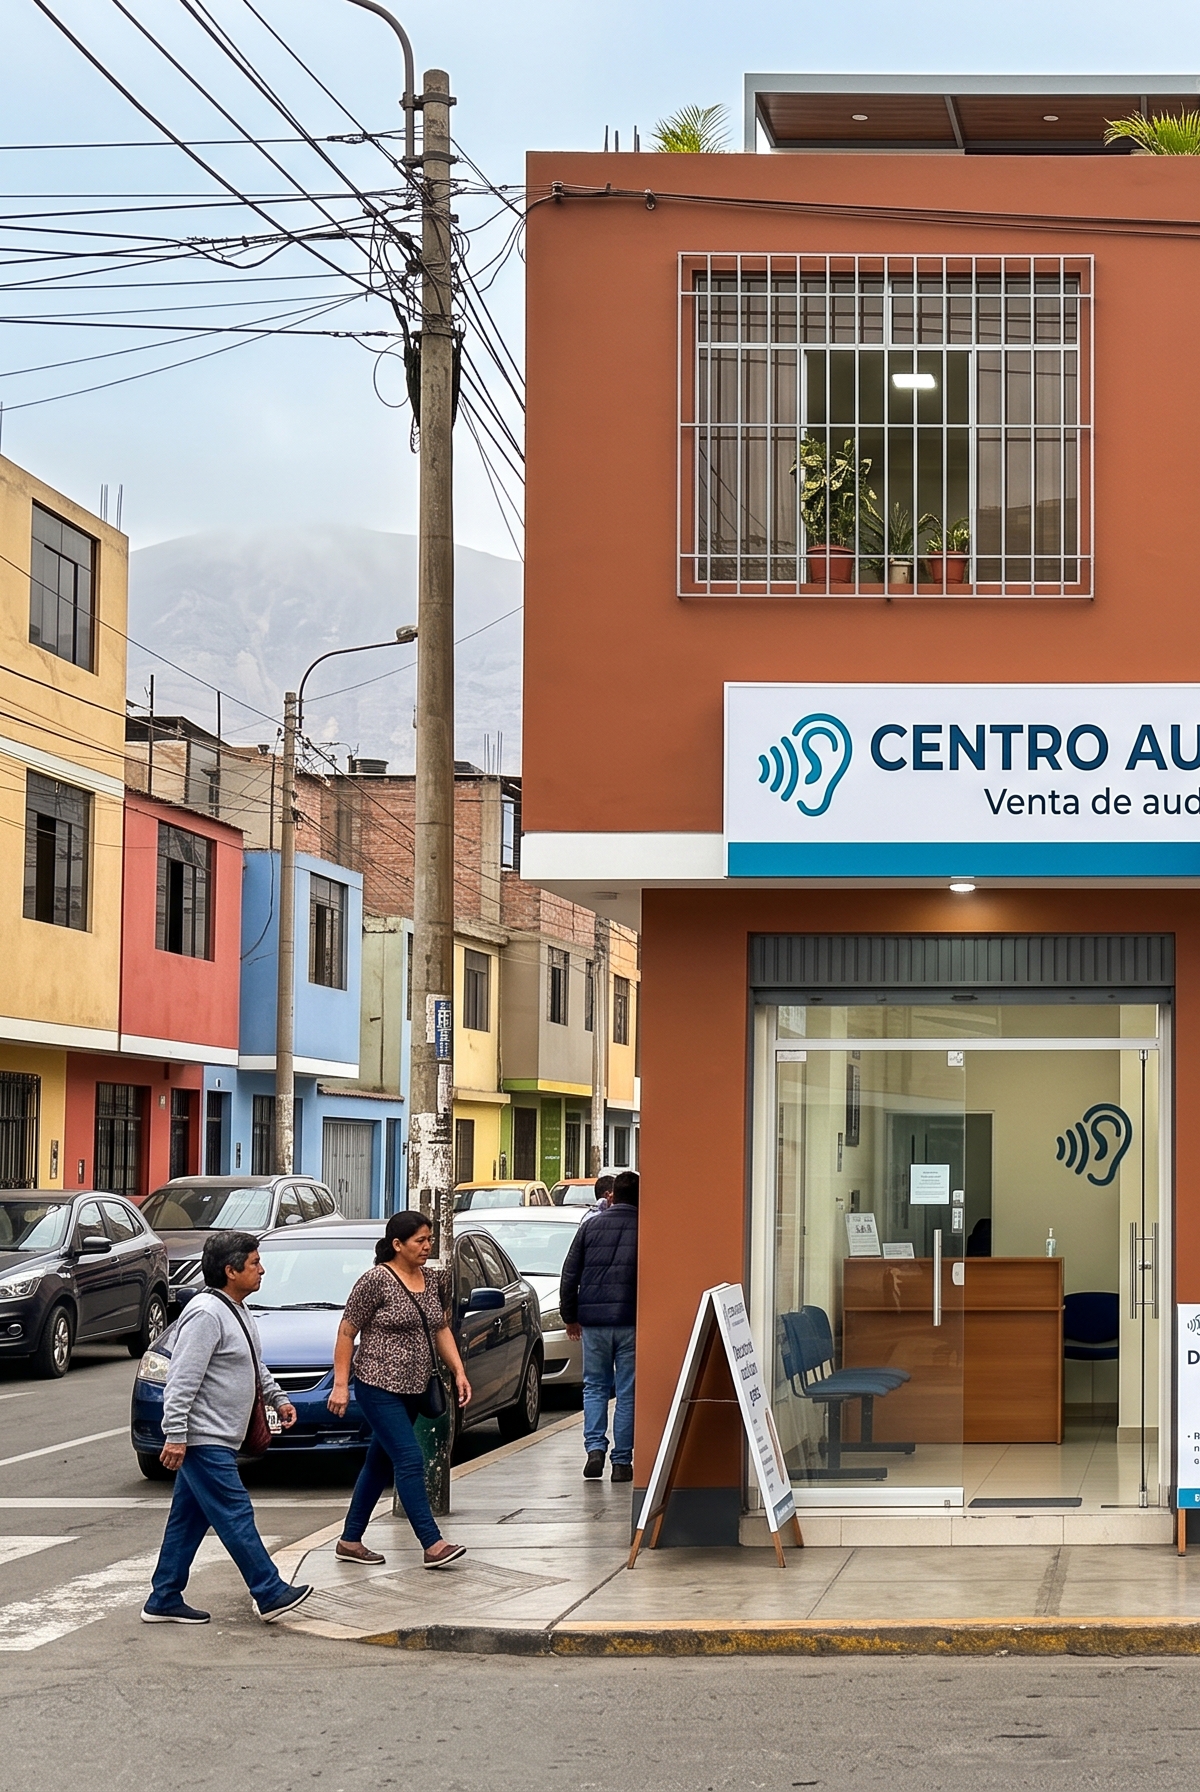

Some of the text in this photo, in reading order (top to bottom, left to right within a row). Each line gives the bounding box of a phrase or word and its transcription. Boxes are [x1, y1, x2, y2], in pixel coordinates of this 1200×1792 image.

[870, 723, 1109, 771] CENTRO
[984, 788, 1080, 815] Venta
[1091, 786, 1132, 815] de
